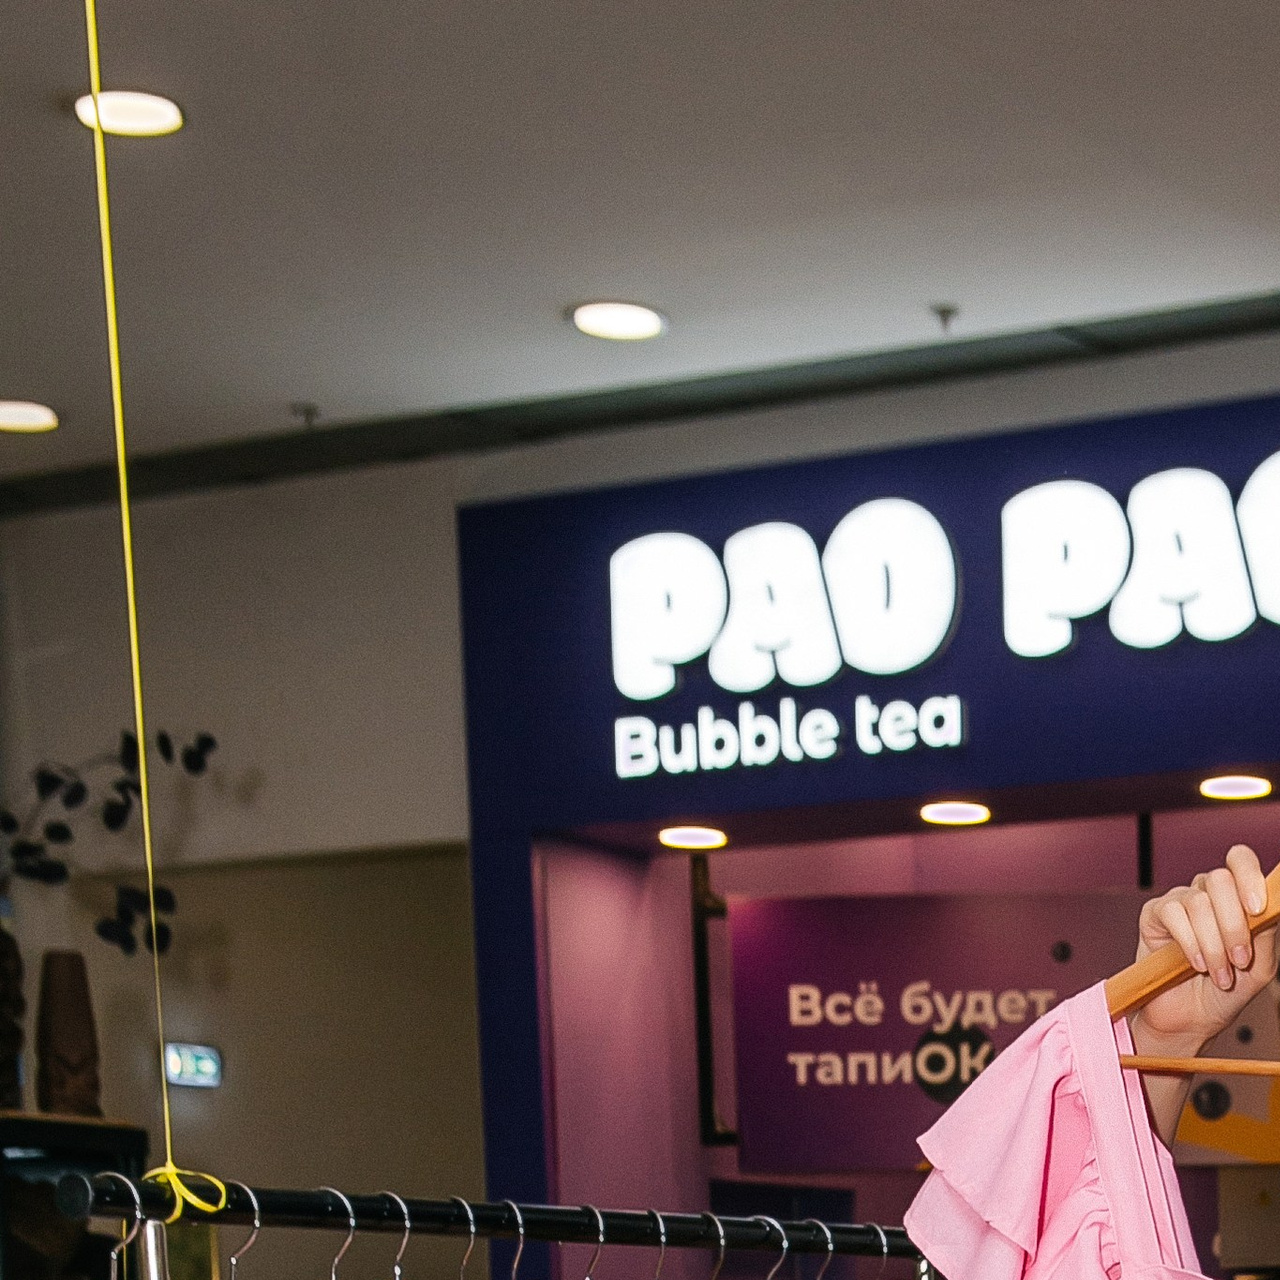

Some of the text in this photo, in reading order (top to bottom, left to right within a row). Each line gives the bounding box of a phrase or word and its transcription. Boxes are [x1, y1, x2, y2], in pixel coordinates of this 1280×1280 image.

[609, 498, 956, 701] PAO
[614, 694, 962, 779] Bubble tea
[788, 980, 1057, 1033] Всё будет
